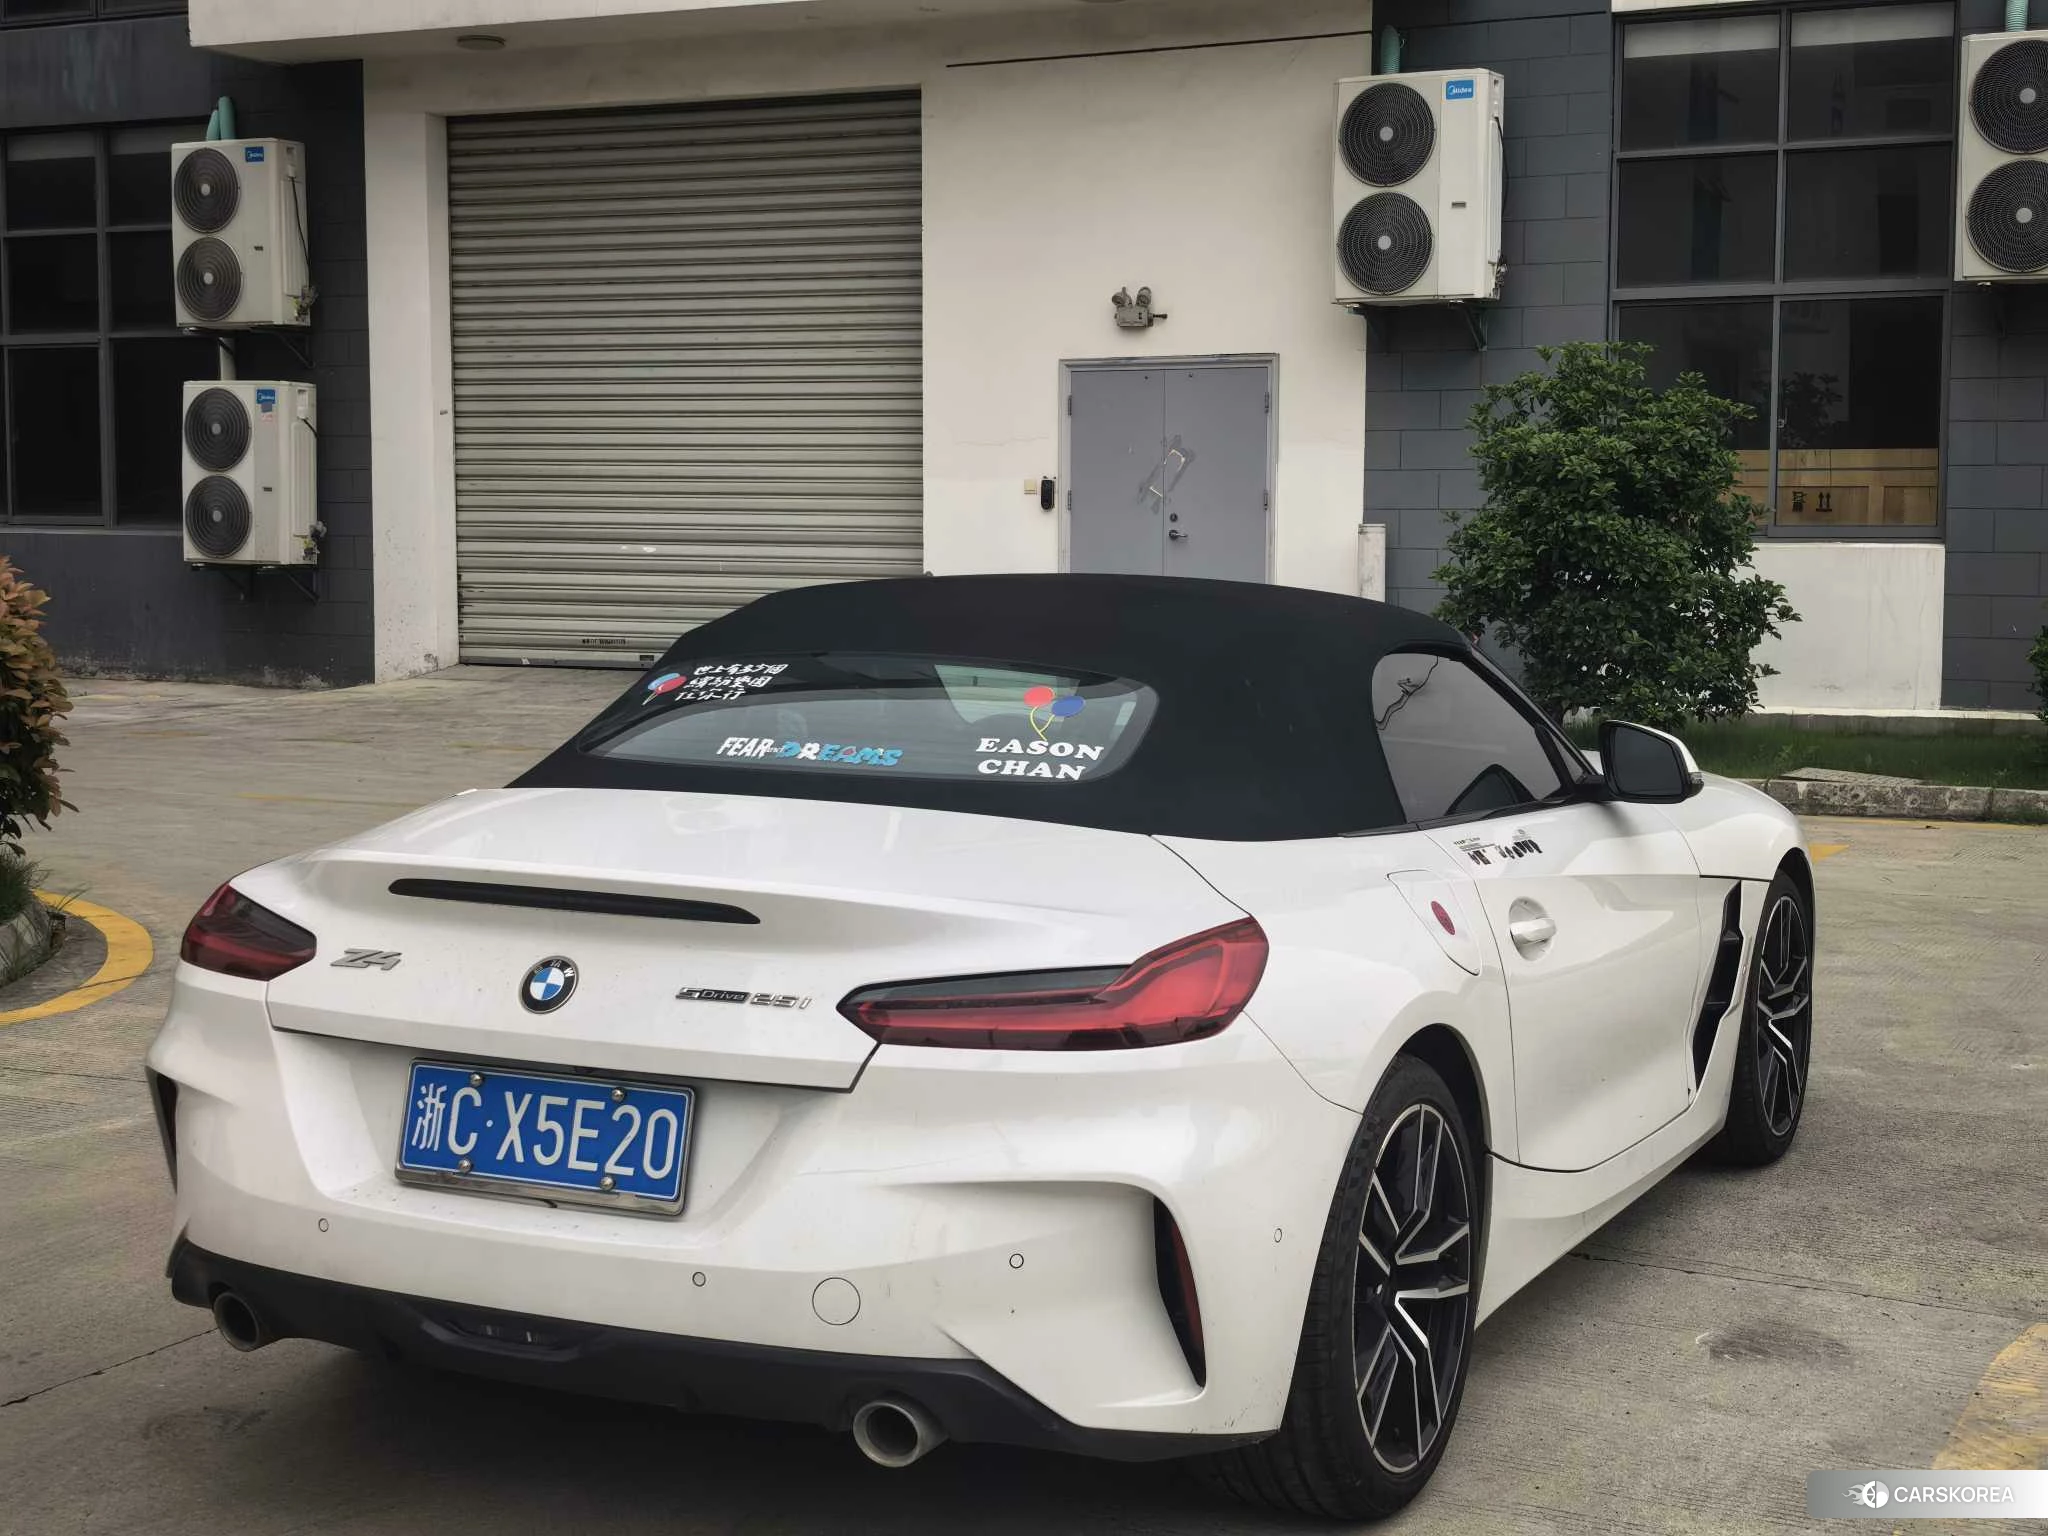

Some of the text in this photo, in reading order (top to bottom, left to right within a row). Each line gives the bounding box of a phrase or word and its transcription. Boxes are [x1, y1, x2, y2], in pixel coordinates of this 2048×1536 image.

[716, 736, 775, 760] FEAR
[776, 740, 903, 767] DREAMS
[975, 737, 1105, 761] EASON
[977, 758, 1086, 781] CHAN
[330, 948, 402, 971] Z4
